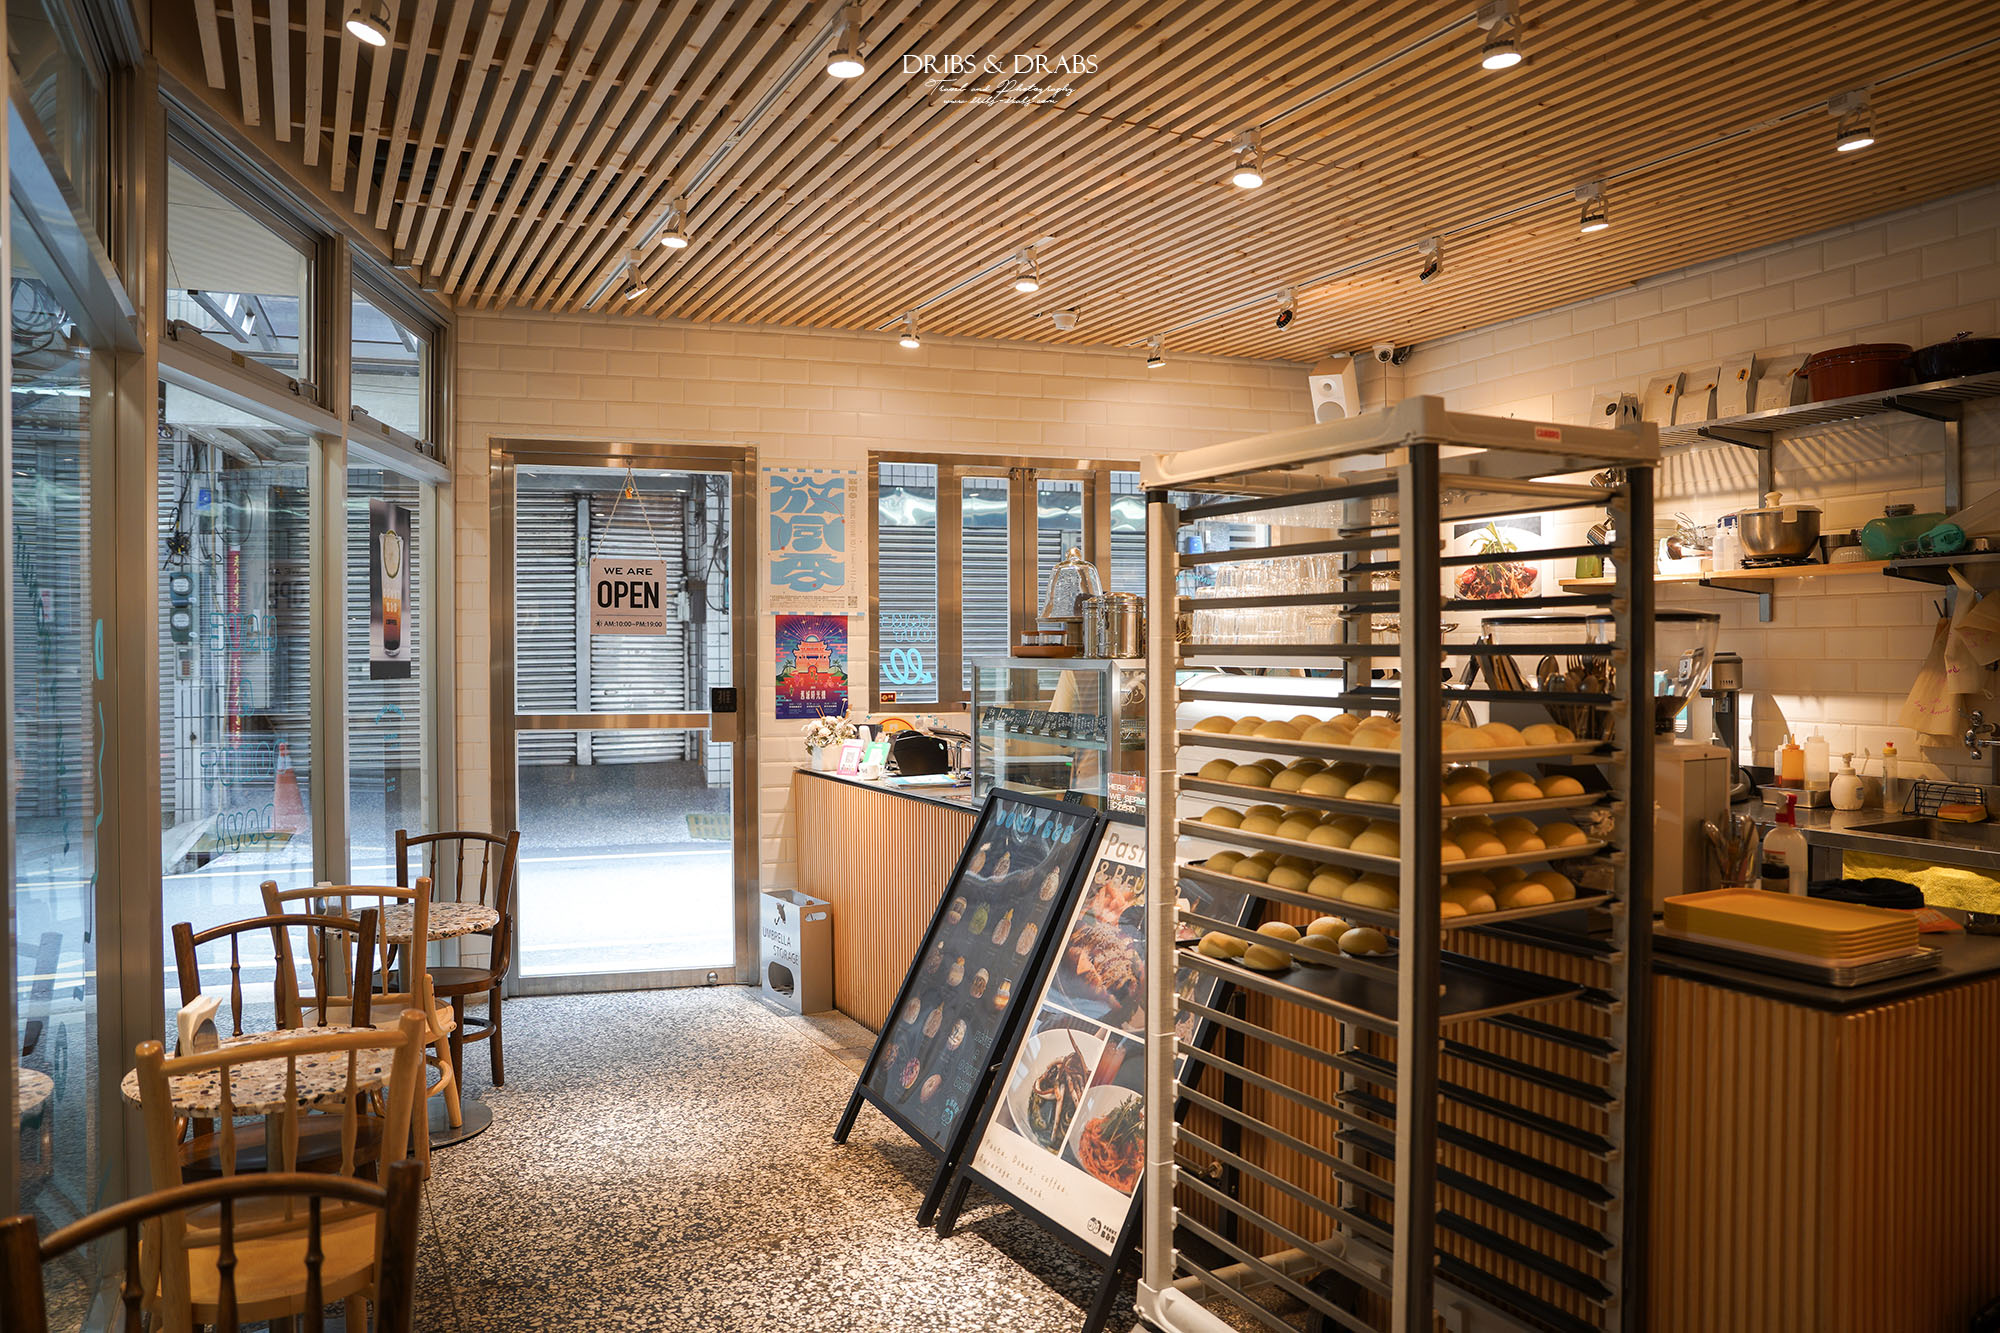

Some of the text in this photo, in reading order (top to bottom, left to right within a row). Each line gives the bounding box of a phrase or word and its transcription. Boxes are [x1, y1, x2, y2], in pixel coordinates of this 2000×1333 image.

[604, 567, 653, 576] WE ARE
[597, 580, 660, 609] OPEN
[762, 927, 792, 947] UMBRELLA
[772, 945, 799, 966] STORAGE
